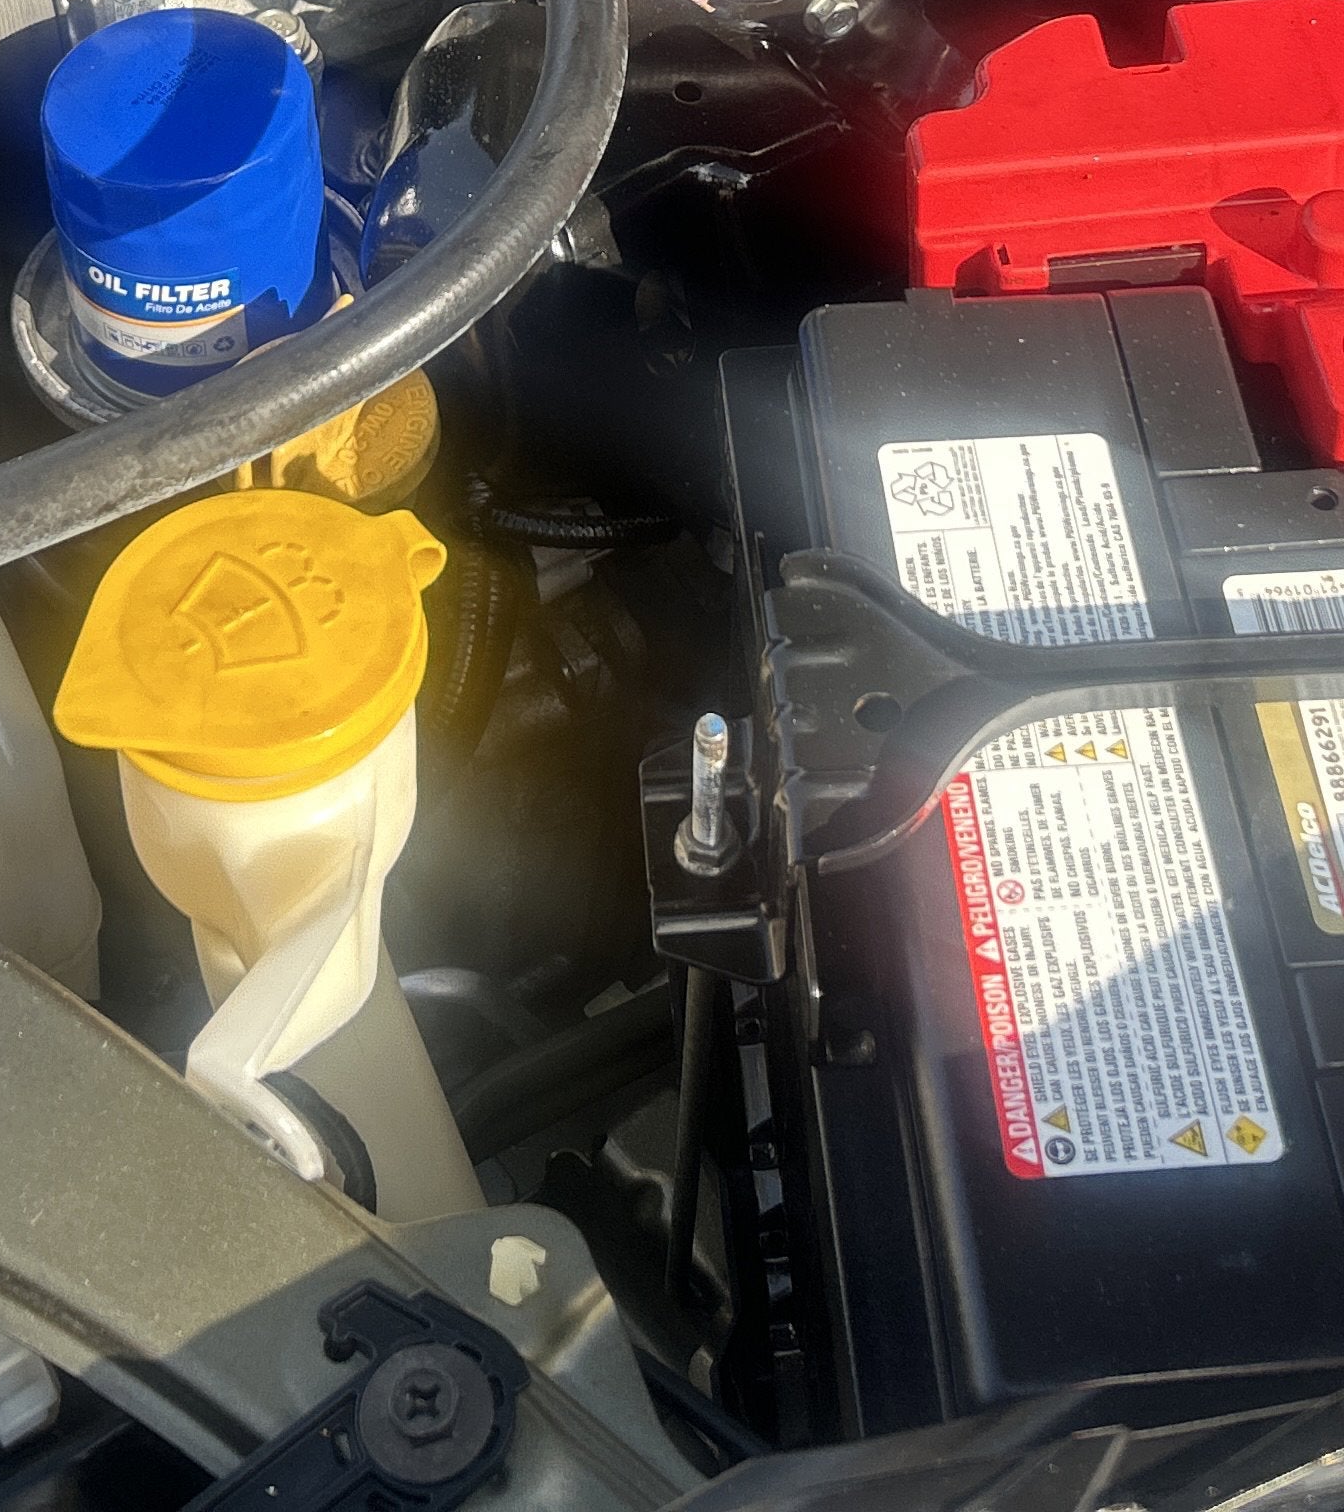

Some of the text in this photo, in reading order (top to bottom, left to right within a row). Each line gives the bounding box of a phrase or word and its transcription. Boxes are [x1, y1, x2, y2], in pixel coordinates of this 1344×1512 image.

[85, 265, 231, 310] OIL FILTER
[145, 302, 173, 315] Filtro
[175, 303, 193, 314] De
[919, 482, 929, 494] Pb
[1111, 524, 1123, 541] CAS
[938, 568, 948, 585] LOS
[942, 587, 951, 598] DE
[977, 595, 987, 605] LA
[1161, 720, 1172, 730] EL
[1165, 734, 1178, 754] CON
[1102, 769, 1118, 803] GRAVES
[1140, 761, 1155, 787] FAST.
[1160, 777, 1172, 792] UN
[1030, 782, 1045, 814] FUMER
[1123, 782, 1140, 818] FUERTES
[1147, 790, 1161, 815] HELP
[1037, 817, 1048, 829] DE
[1164, 795, 1187, 854] CONSULTER
[1182, 796, 1198, 831] ACUDA
[1002, 826, 1020, 872] SMOKING
[1132, 821, 1155, 884] QUEMADURAS
[1153, 818, 1173, 864] MEDICAL
[991, 860, 1004, 876] NO
[1079, 846, 1099, 896] CIGARROS
[1121, 853, 1133, 870] DES
[1290, 801, 1343, 914] ACDelco
[1031, 878, 1045, 899] PAS
[1068, 880, 1081, 896] NO
[1165, 867, 1178, 886] GET
[1200, 873, 1214, 895] CON
[1051, 886, 1062, 898] DE
[1109, 877, 1124, 909] SEVERE
[1137, 922, 1148, 933] LA
[1150, 896, 1167, 938] CEGUERA
[1038, 916, 1060, 973] EXPLOSIFS
[1074, 909, 1098, 976] EXPLOSIVOS
[1140, 935, 1157, 972] CAUSER
[1181, 932, 1197, 961] WITH
[1206, 898, 1239, 996] INMEDIATAMENTE
[944, 780, 1033, 1139] DANGER/POISON PELIGRO/VENENO
[1028, 963, 1039, 976] OR
[1159, 941, 1177, 979] CAUSAR
[1050, 976, 1065, 998] GAZ
[1089, 979, 1106, 1015] GASES
[1130, 976, 1145, 1007] CAUSE
[1149, 976, 1163, 999] PEUT
[1169, 982, 1185, 1012] PUEDE
[1189, 964, 1216, 1039] IMMEDIATELY
[1003, 926, 1047, 1102] SHIELD EXPLOSIVE GASES
[1031, 982, 1051, 1037] BLINDNESS
[1055, 1002, 1070, 1022] LES
[1138, 1010, 1151, 1030] CAN
[1214, 998, 1229, 1027] YEUX
[1231, 1000, 1247, 1029] OJOS
[1075, 1005, 1093, 1045] RENDRE
[1097, 1019, 1112, 1041] LOS
[1154, 1002, 1179, 1069] SULFURIQUE
[1142, 1034, 1157, 1060] ACID
[1222, 1030, 1235, 1050] LES
[1240, 1032, 1253, 1054] LOS
[1042, 1038, 1058, 1075] CAUSE
[1084, 1048, 1096, 1062] OU
[1207, 1043, 1223, 1072] EYES
[1067, 1060, 1082, 1080] LES
[1227, 1053, 1246, 1094] RINSER
[1246, 1056, 1268, 1111] ENJUAGE
[1050, 1078, 1063, 1101] CAN
[1088, 1065, 1106, 1109] BLESSER
[1109, 1079, 1124, 1102] LOS
[1127, 1071, 1146, 1113] CAUSAR
[1148, 1063, 1170, 1118] SULFURIC
[1170, 1074, 1191, 1118] L'ACIDE
[1215, 1077, 1233, 1114] FLUSH
[1238, 1097, 1250, 1112] SE
[1097, 1112, 1116, 1161] PEUVENT
[1115, 1104, 1137, 1160] PROTEJA
[1137, 1116, 1156, 1159] PUEDEN
[1085, 1146, 1098, 1161] SE
